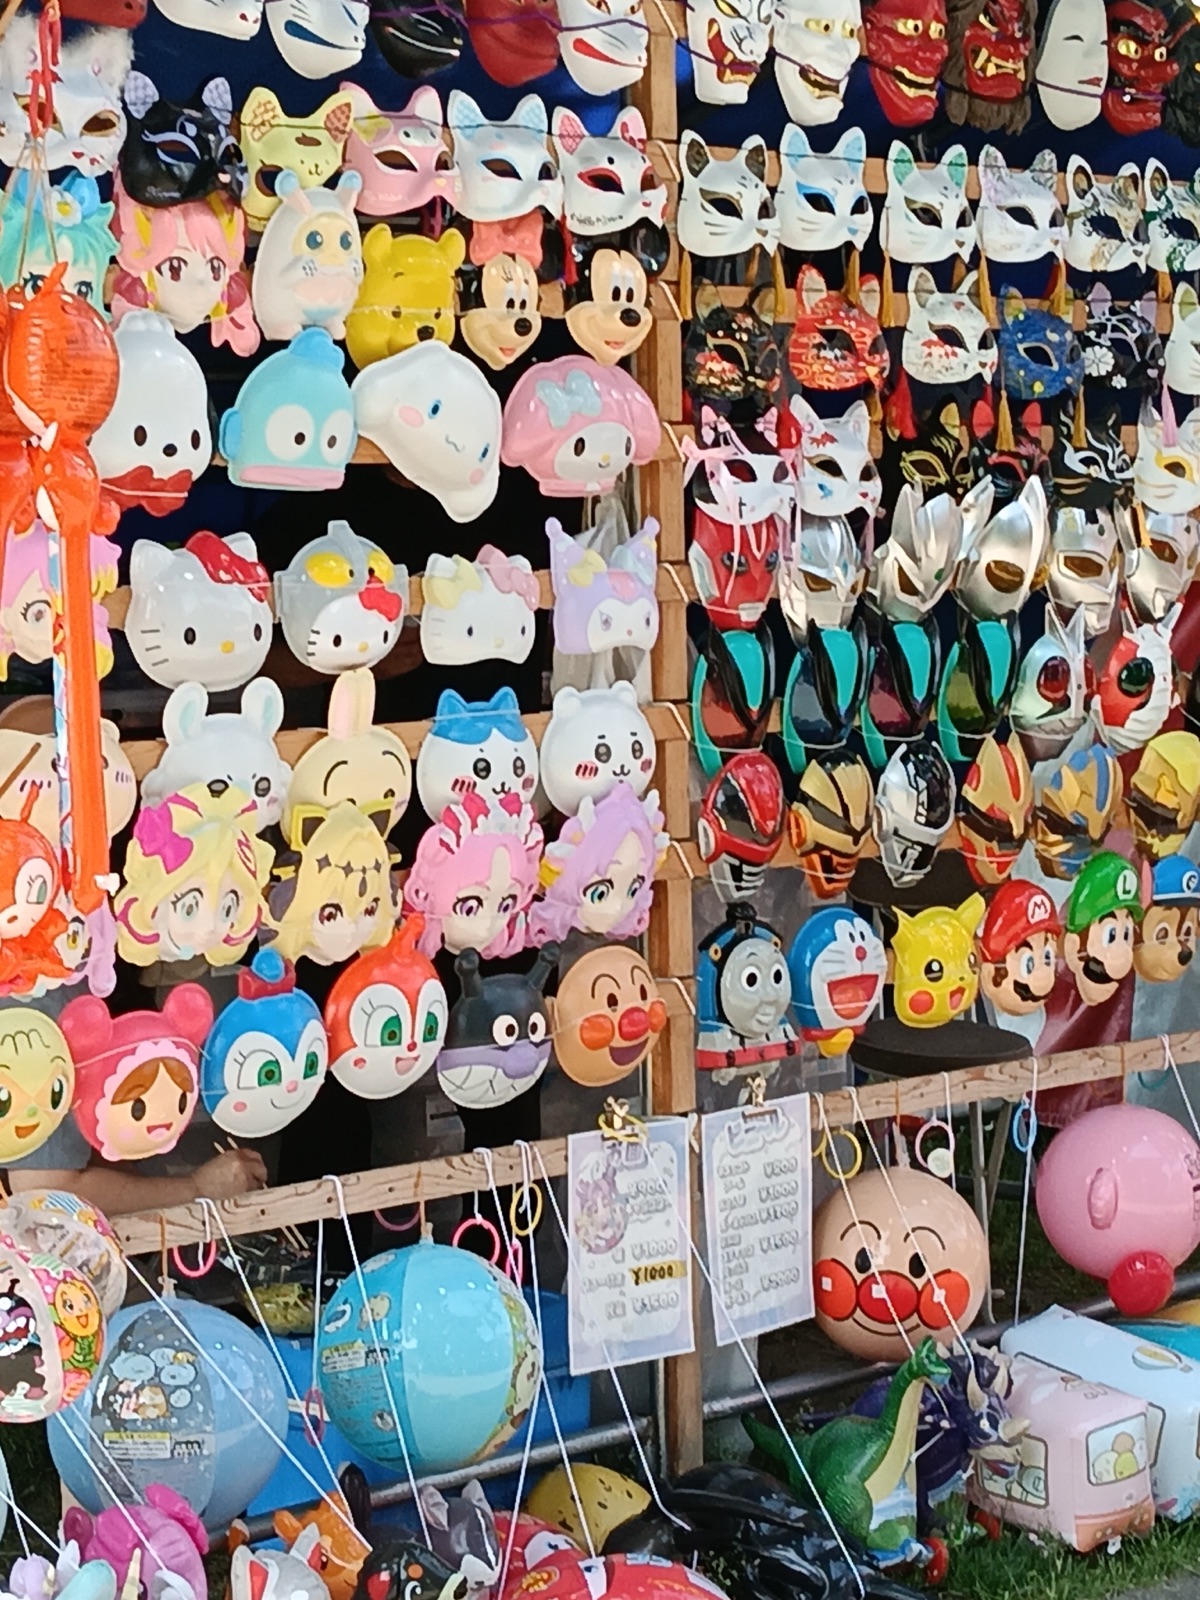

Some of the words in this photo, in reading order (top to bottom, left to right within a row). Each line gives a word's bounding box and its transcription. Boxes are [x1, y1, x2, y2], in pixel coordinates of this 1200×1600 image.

[1122, 874, 1132, 895] L
[1030, 898, 1049, 919] M
[631, 1237, 678, 1261] ¥1000
[630, 1264, 674, 1287] ¥1000
